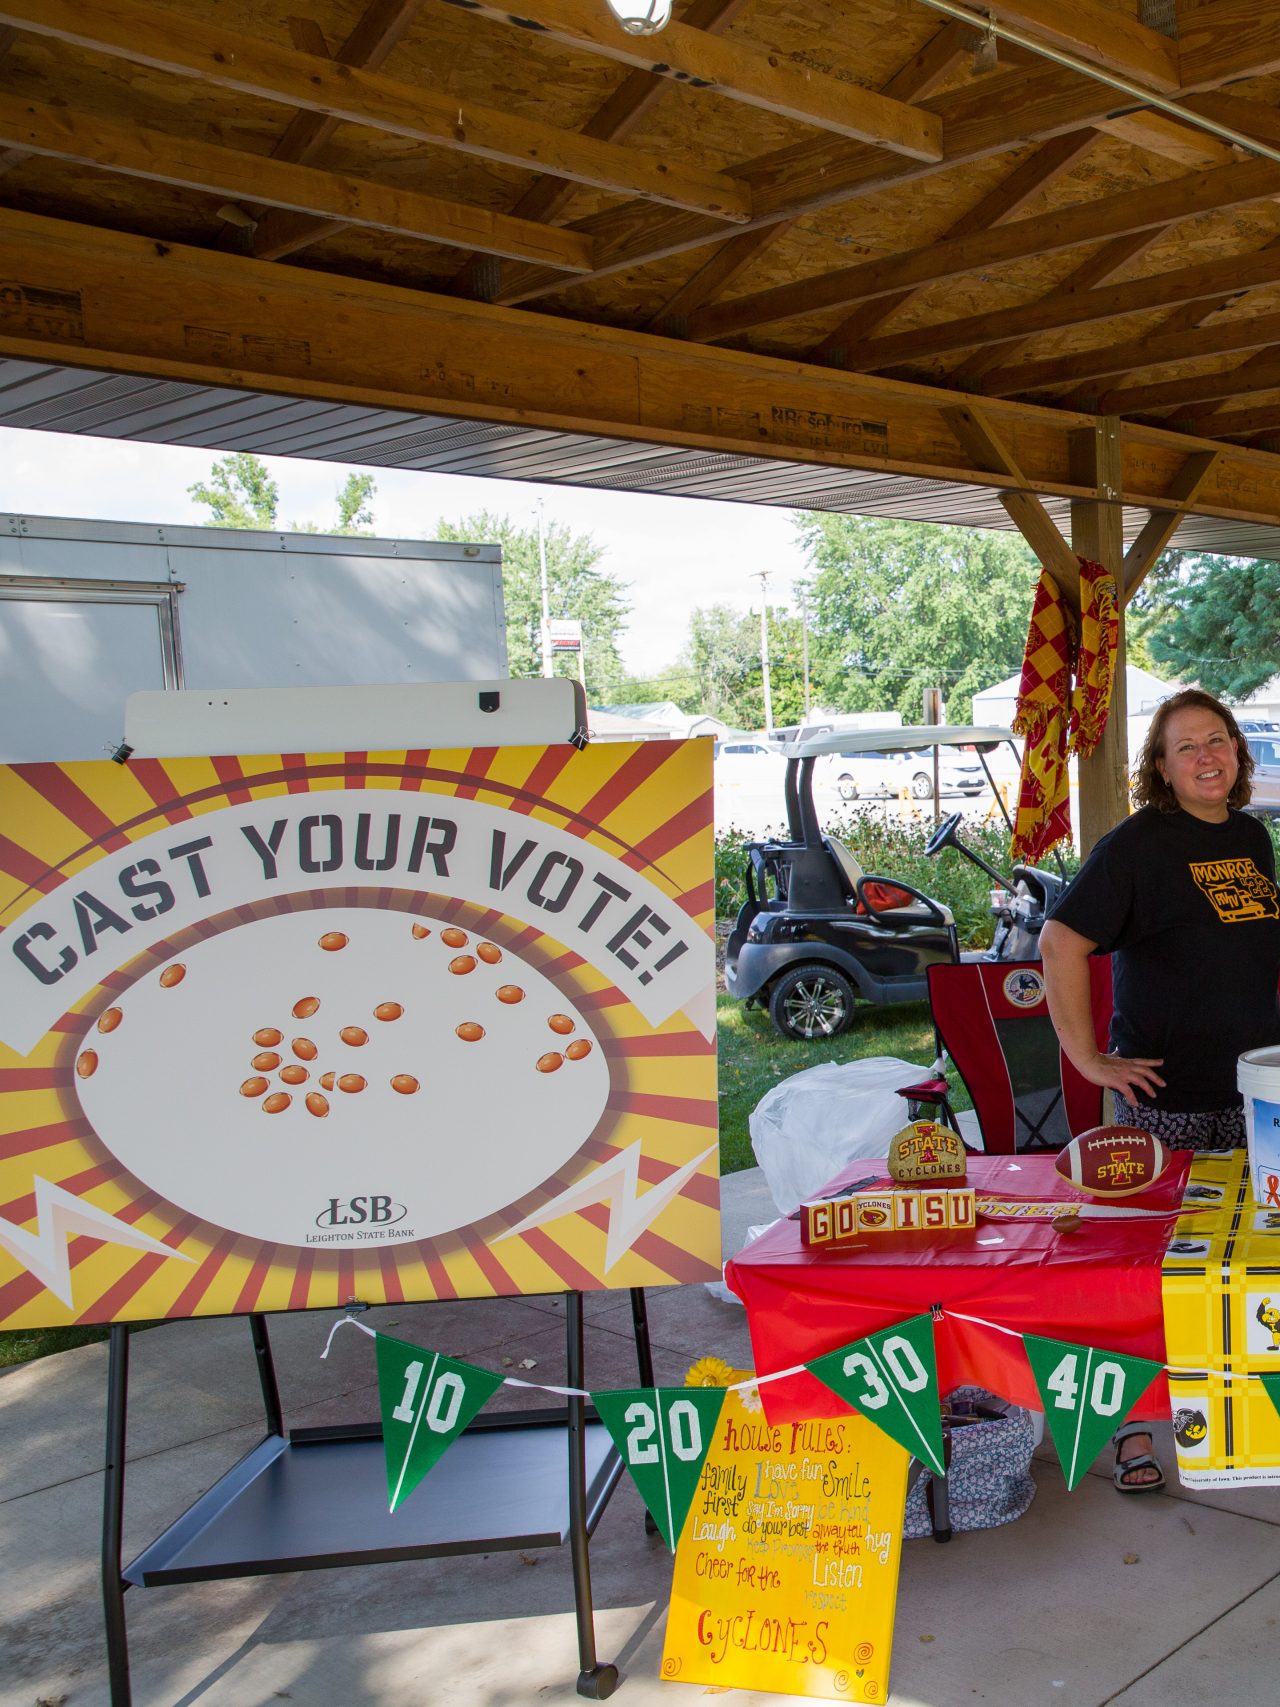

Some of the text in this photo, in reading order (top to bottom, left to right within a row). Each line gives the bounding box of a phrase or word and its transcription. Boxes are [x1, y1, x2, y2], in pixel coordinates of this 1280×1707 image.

[1194, 860, 1257, 883] MONROE
[12, 813, 690, 986] CAST YOUR VOTE!
[898, 1135, 958, 1160] STATE
[898, 1164, 961, 1178] CYCLONES
[1097, 1162, 1145, 1178] STATE
[328, 1195, 392, 1225] LSB
[812, 1201, 854, 1238] GO
[901, 1195, 970, 1227] ISU
[842, 1335, 929, 1410] 30
[1046, 1353, 1126, 1417] 40
[392, 1360, 466, 1434] 10
[624, 1400, 703, 1465] 20
[701, 1462, 748, 1502] family
[753, 1462, 799, 1501] Love
[764, 1457, 824, 1481] have fun
[703, 1491, 738, 1517] first
[692, 1516, 737, 1553] Laugh
[742, 1516, 810, 1543] do your best
[864, 1524, 891, 1565] hug
[815, 1540, 829, 1555] the
[832, 1539, 861, 1558] truth
[695, 1552, 734, 1580] Cheer
[757, 1565, 781, 1592] the
[812, 1552, 863, 1589] Listen
